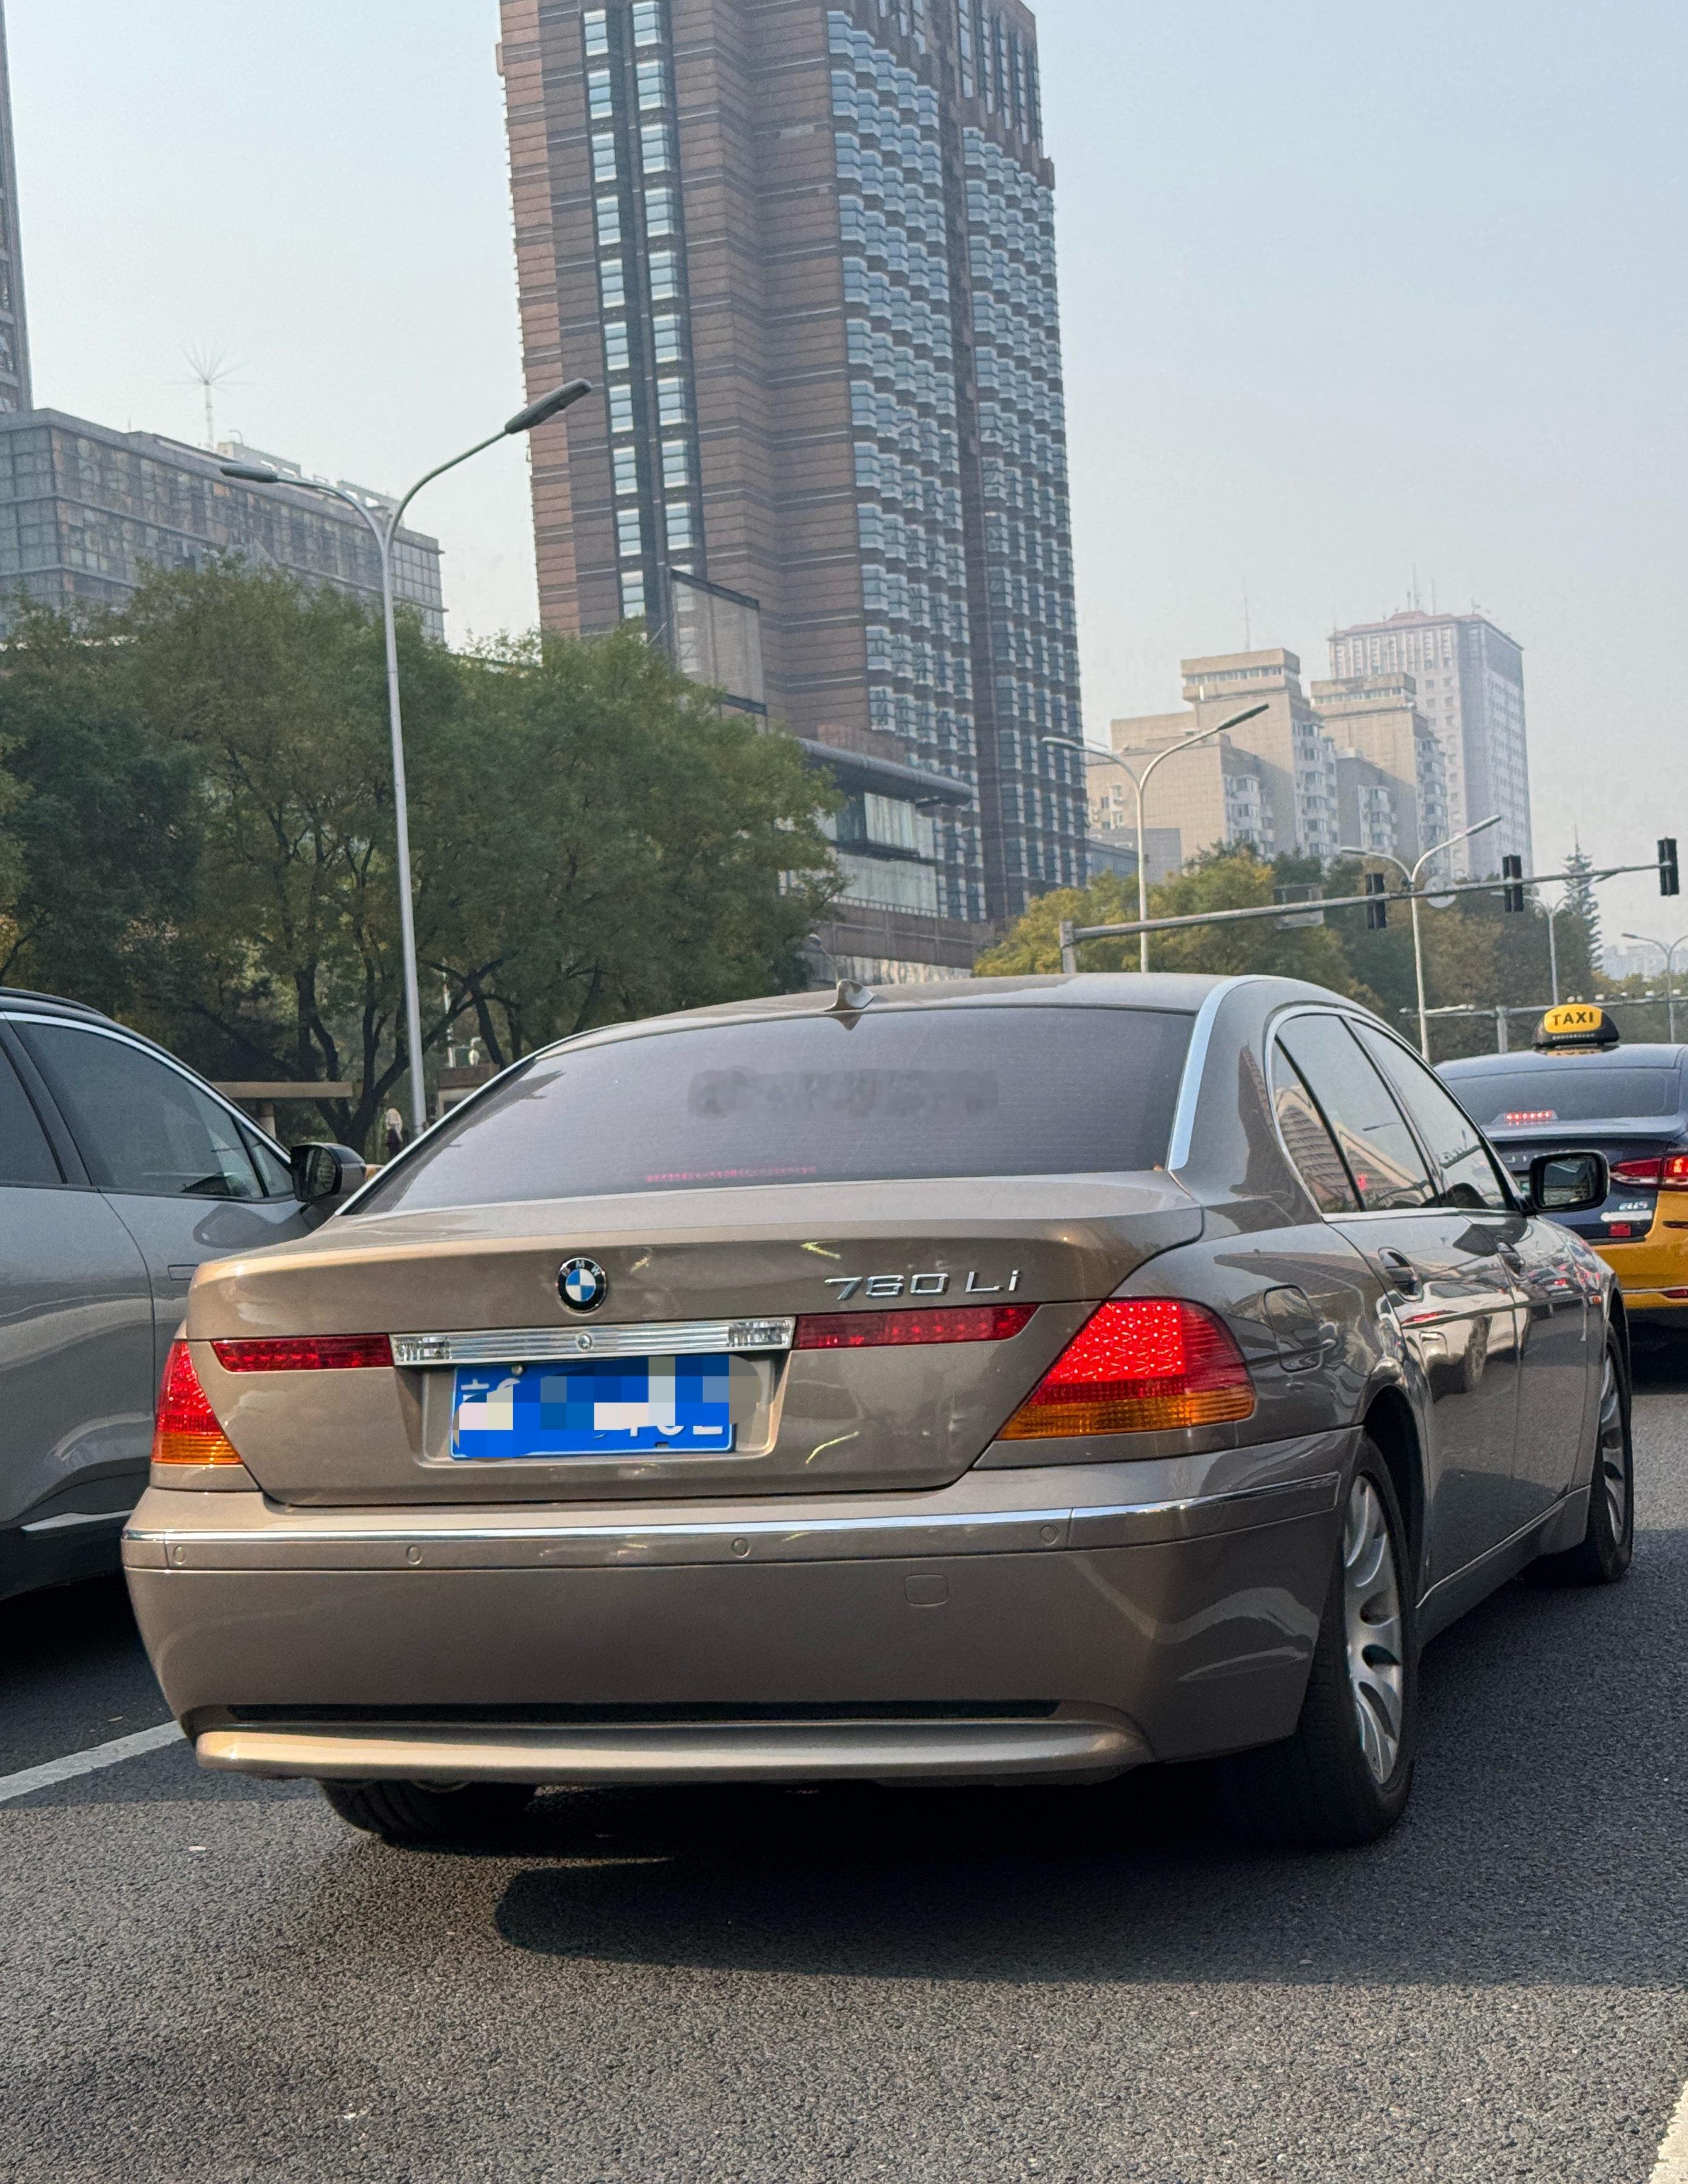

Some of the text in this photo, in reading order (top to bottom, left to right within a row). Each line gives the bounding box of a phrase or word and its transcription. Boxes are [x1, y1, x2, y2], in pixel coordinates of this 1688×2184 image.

[1553, 1011, 1594, 1026] TAXI
[562, 1260, 601, 1277] BMW
[824, 1270, 1019, 1300] 760 Li
